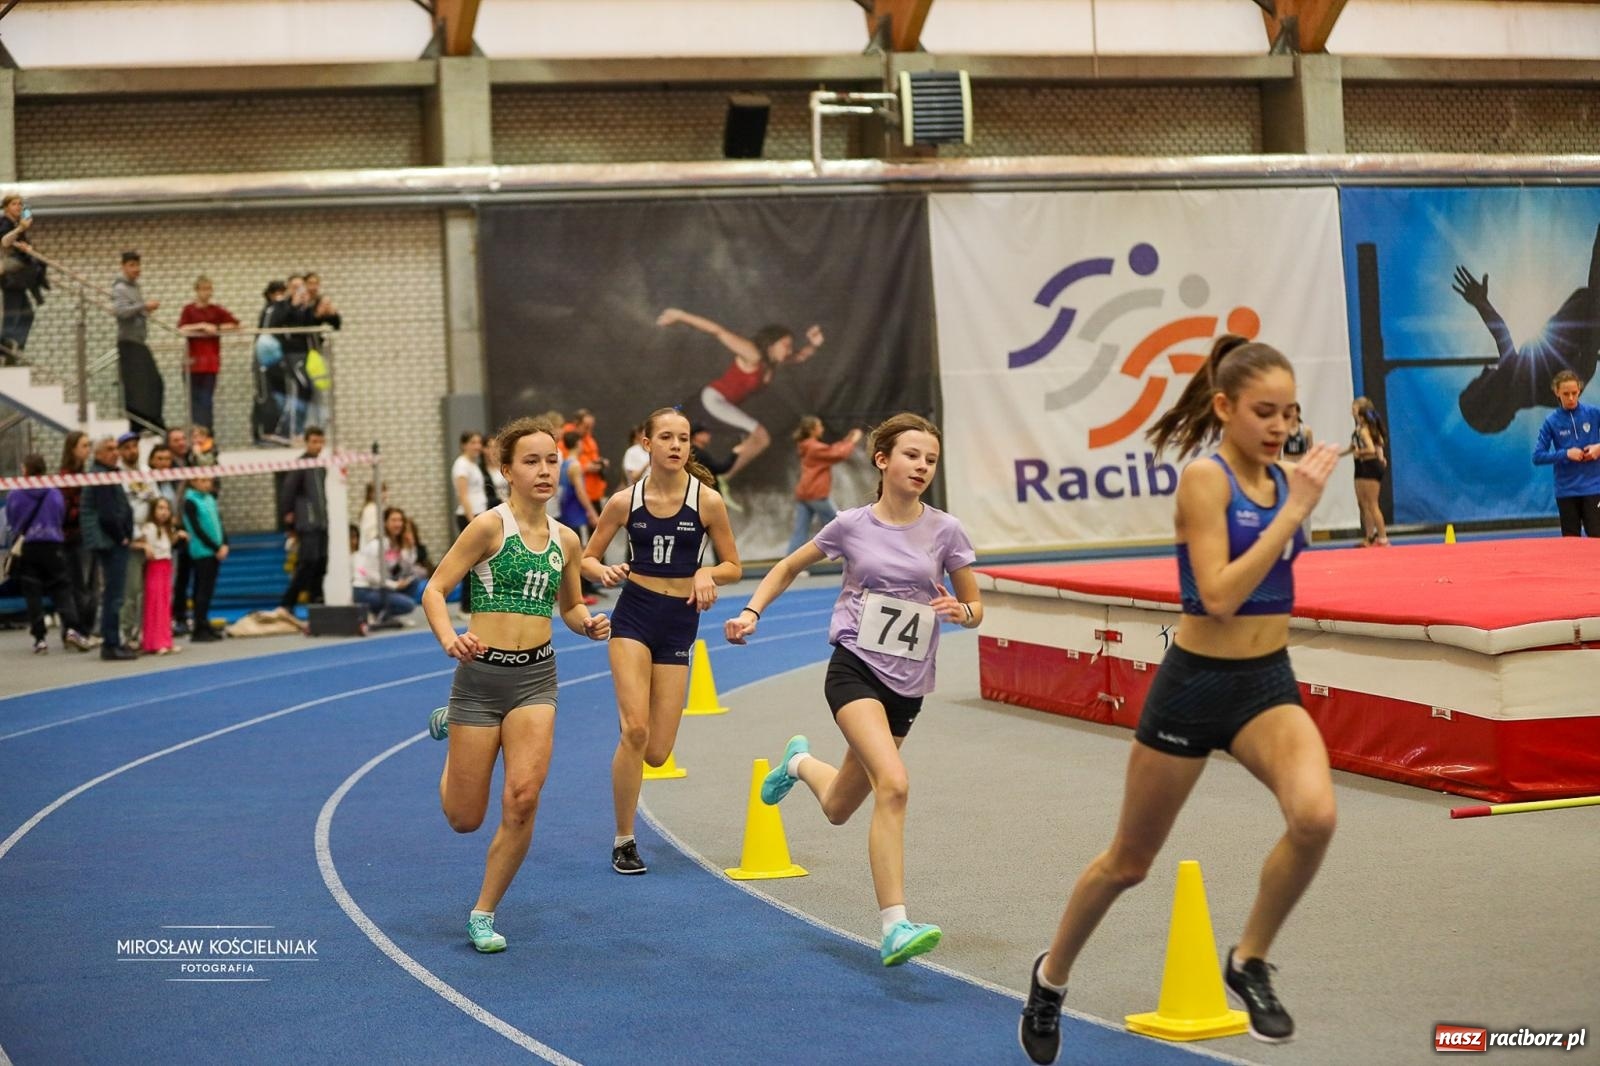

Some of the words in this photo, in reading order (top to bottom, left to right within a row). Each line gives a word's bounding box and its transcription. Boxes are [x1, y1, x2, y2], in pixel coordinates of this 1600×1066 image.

[1014, 452, 1178, 503] Racib
[653, 535, 675, 563] 87
[521, 569, 549, 601] 111
[877, 605, 920, 652] 74
[488, 651, 530, 664] PRO
